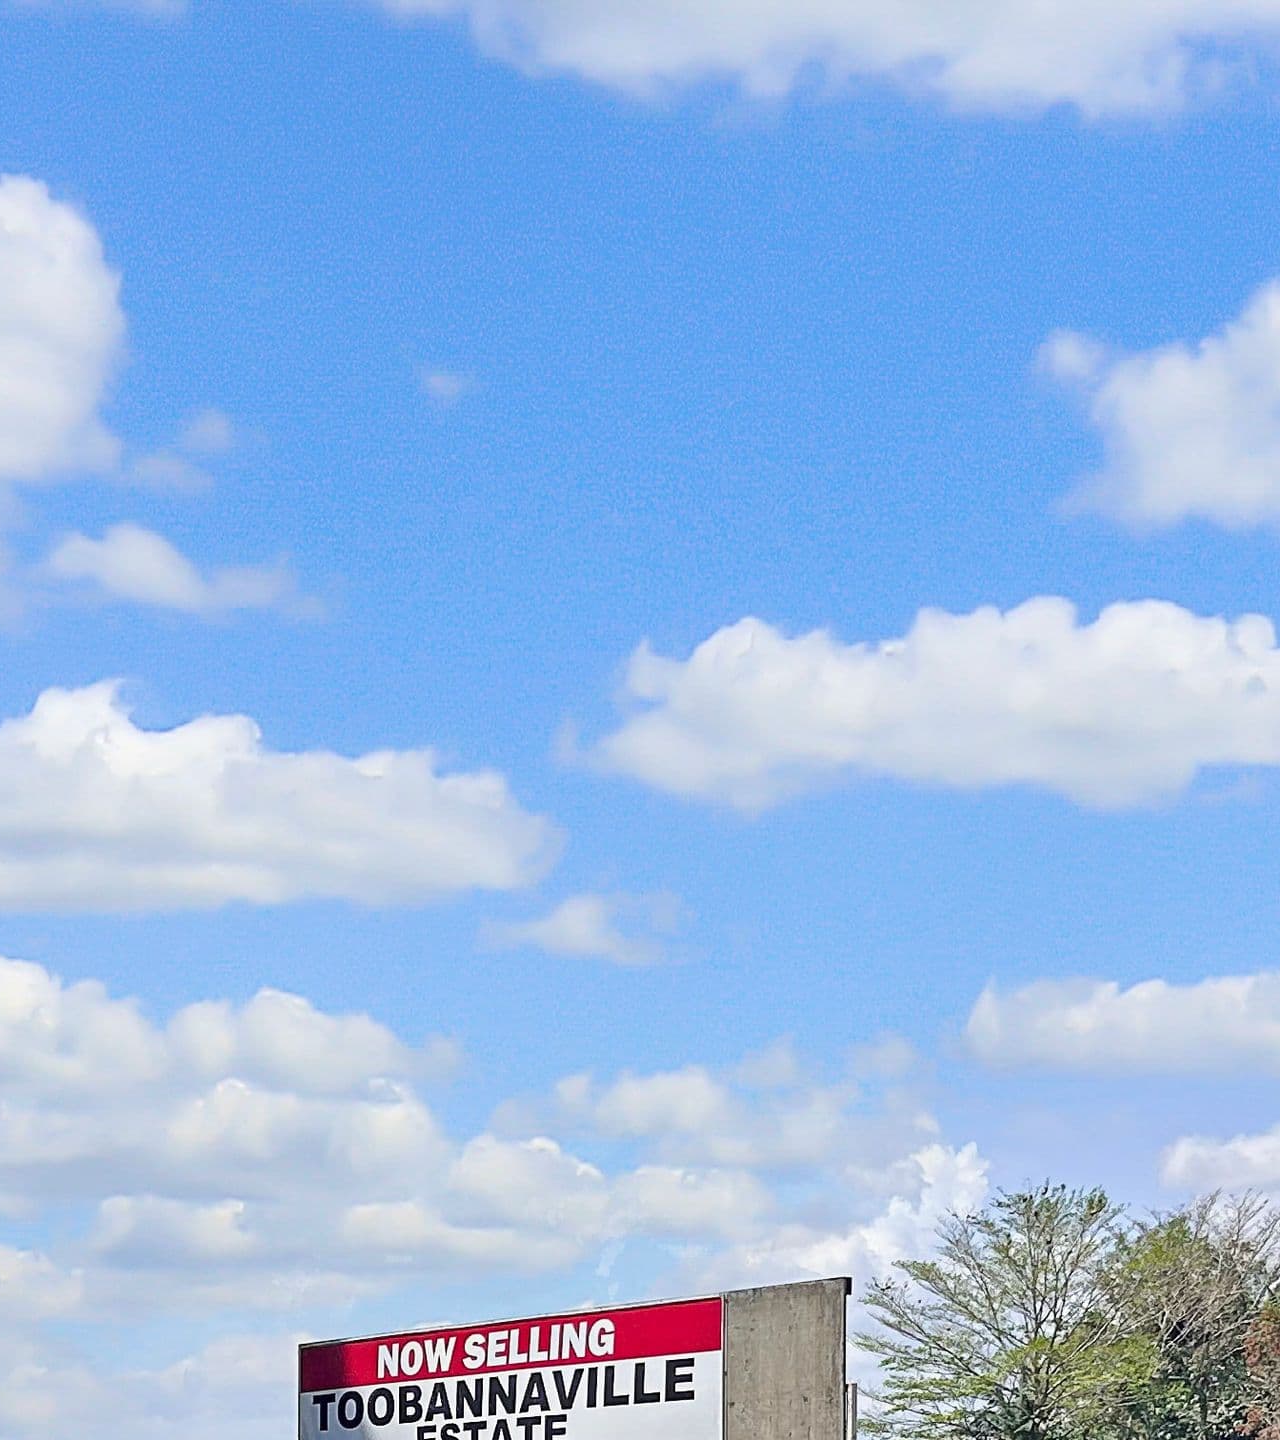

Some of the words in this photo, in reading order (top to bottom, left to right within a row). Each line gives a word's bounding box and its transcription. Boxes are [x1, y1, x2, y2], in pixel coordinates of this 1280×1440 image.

[377, 1336, 457, 1379] NOW
[462, 1318, 615, 1368] SELLING
[312, 1357, 695, 1432] TOOBANNAVILLE
